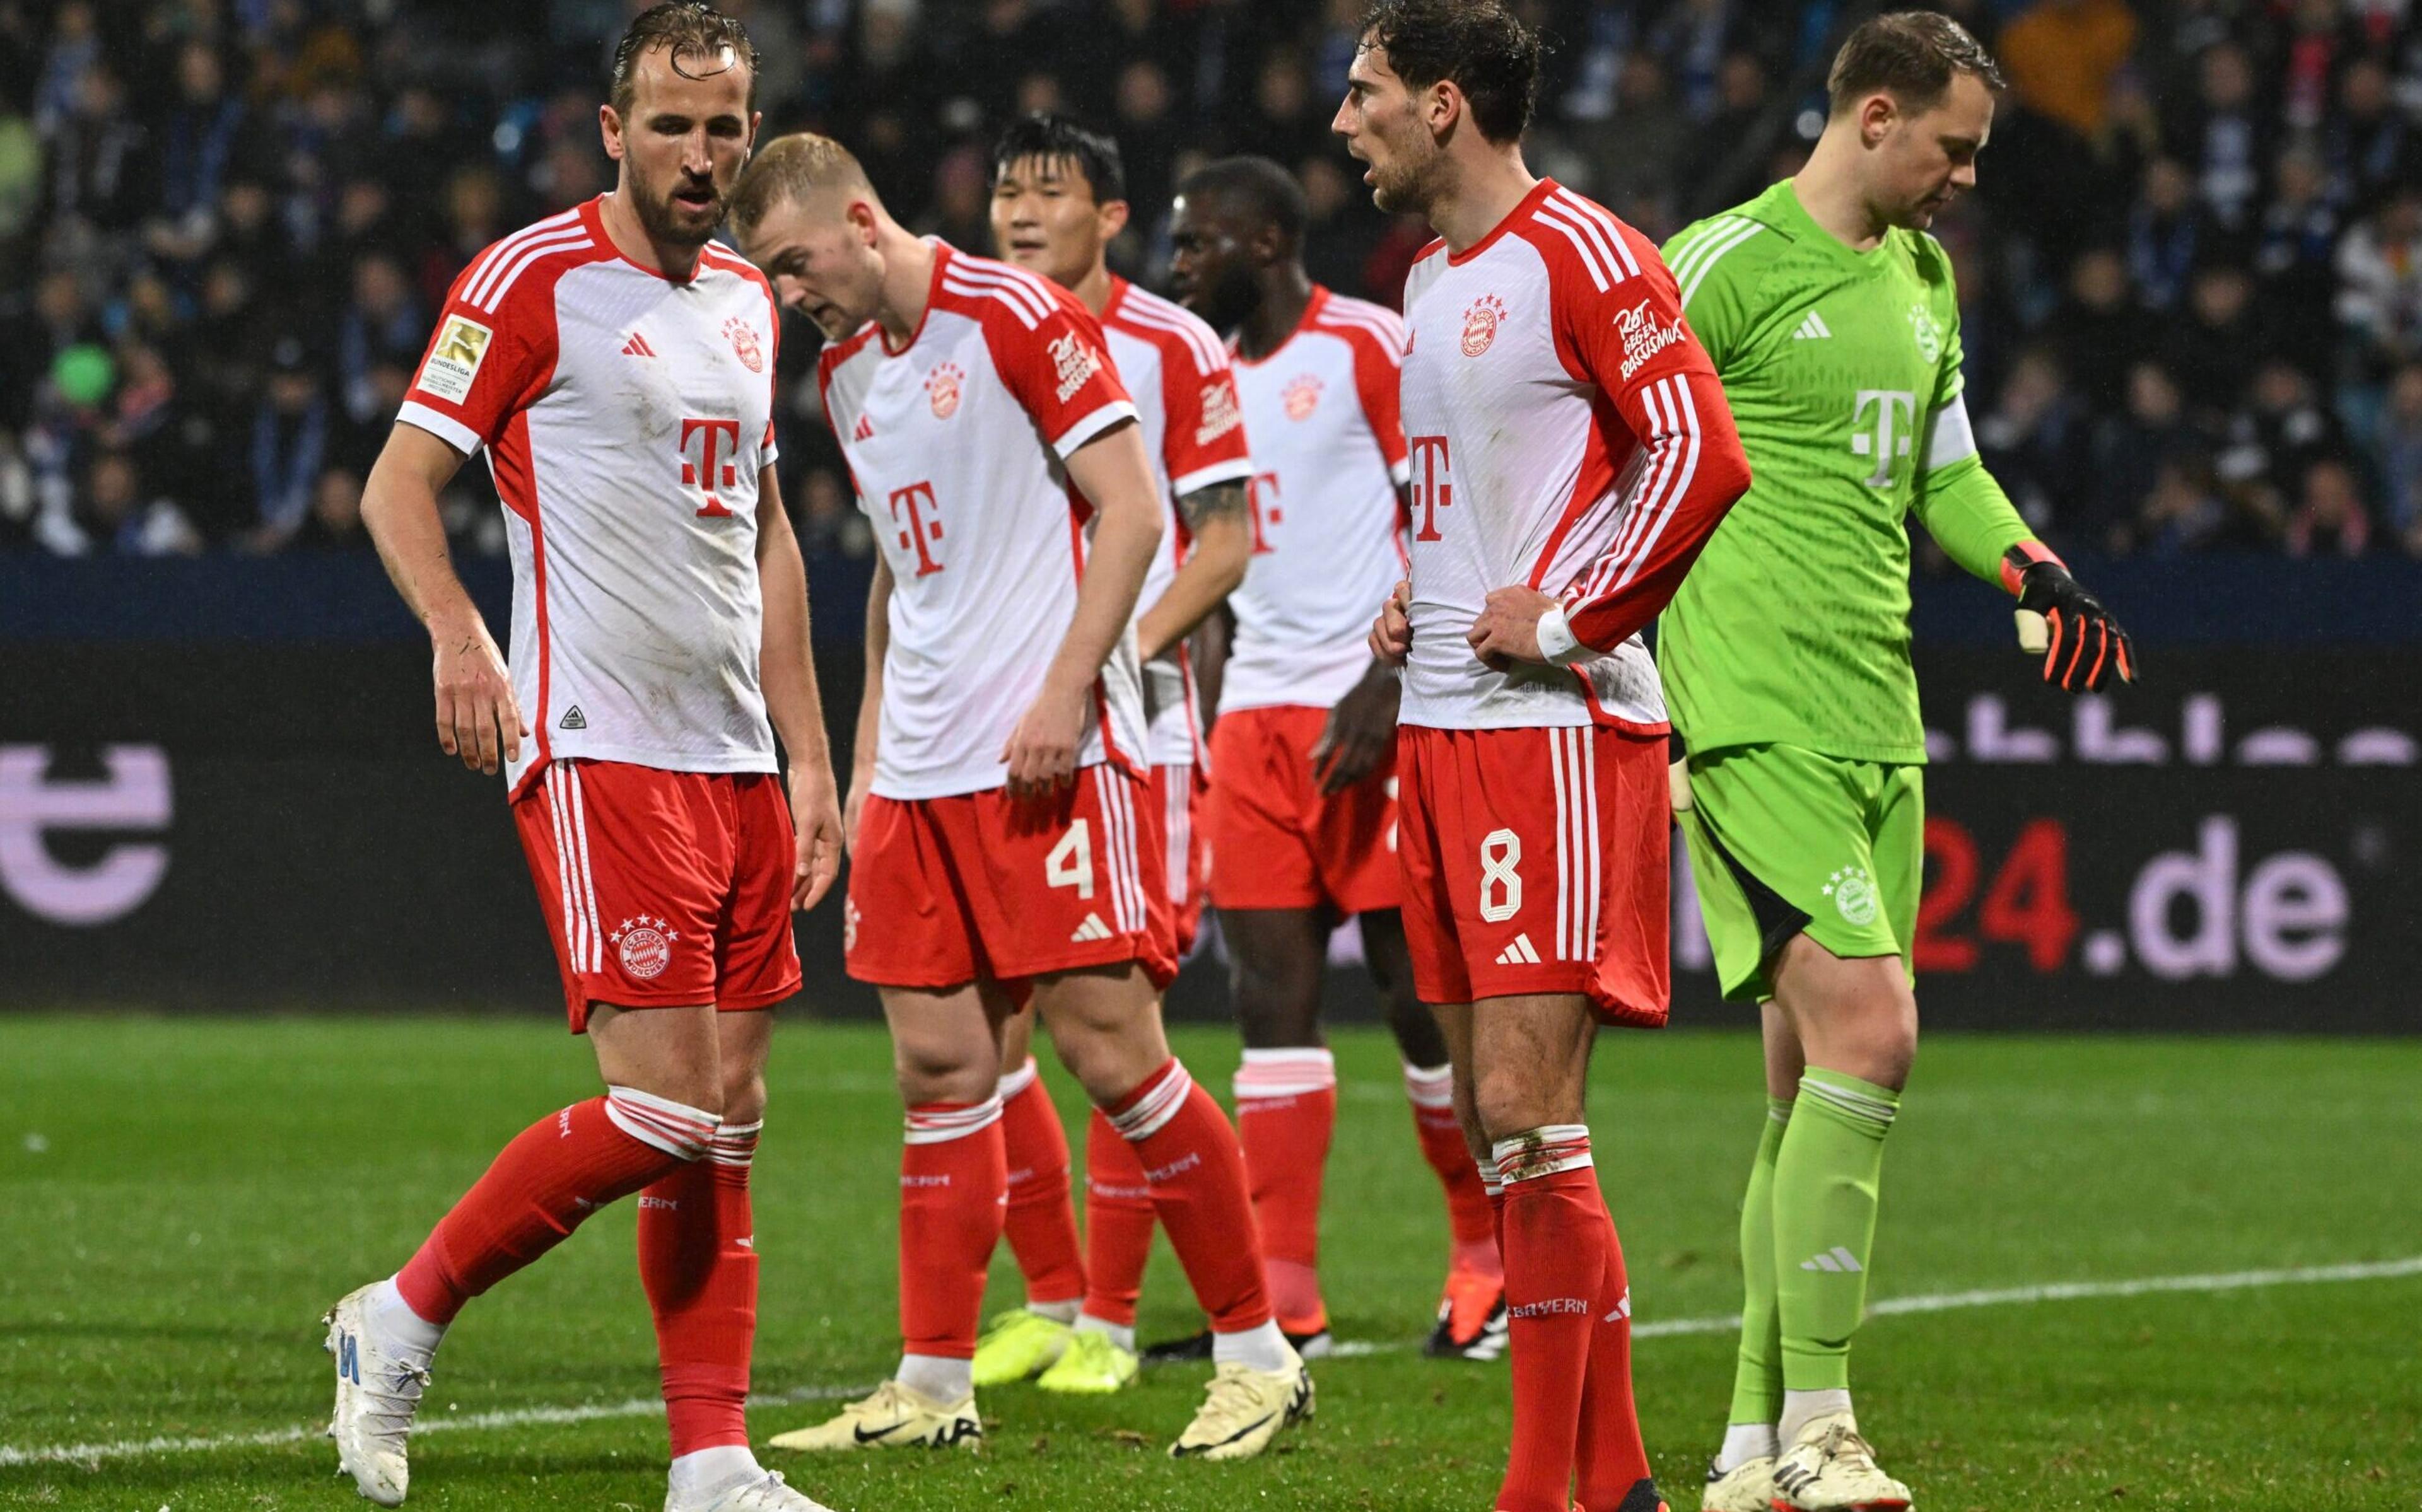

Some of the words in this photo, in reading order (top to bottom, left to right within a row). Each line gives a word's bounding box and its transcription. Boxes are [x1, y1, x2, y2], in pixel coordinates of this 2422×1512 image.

[1613, 298, 1650, 340] ROT
[1623, 311, 1658, 355] GEGEN
[431, 358, 470, 376] BUNDESLIGA
[1620, 317, 1686, 382] RASSISMUS
[1045, 818, 1094, 900] 4
[1480, 828, 1521, 922] 8
[633, 932, 665, 951] BAYERN
[1513, 1298, 1588, 1318] BAYERN
